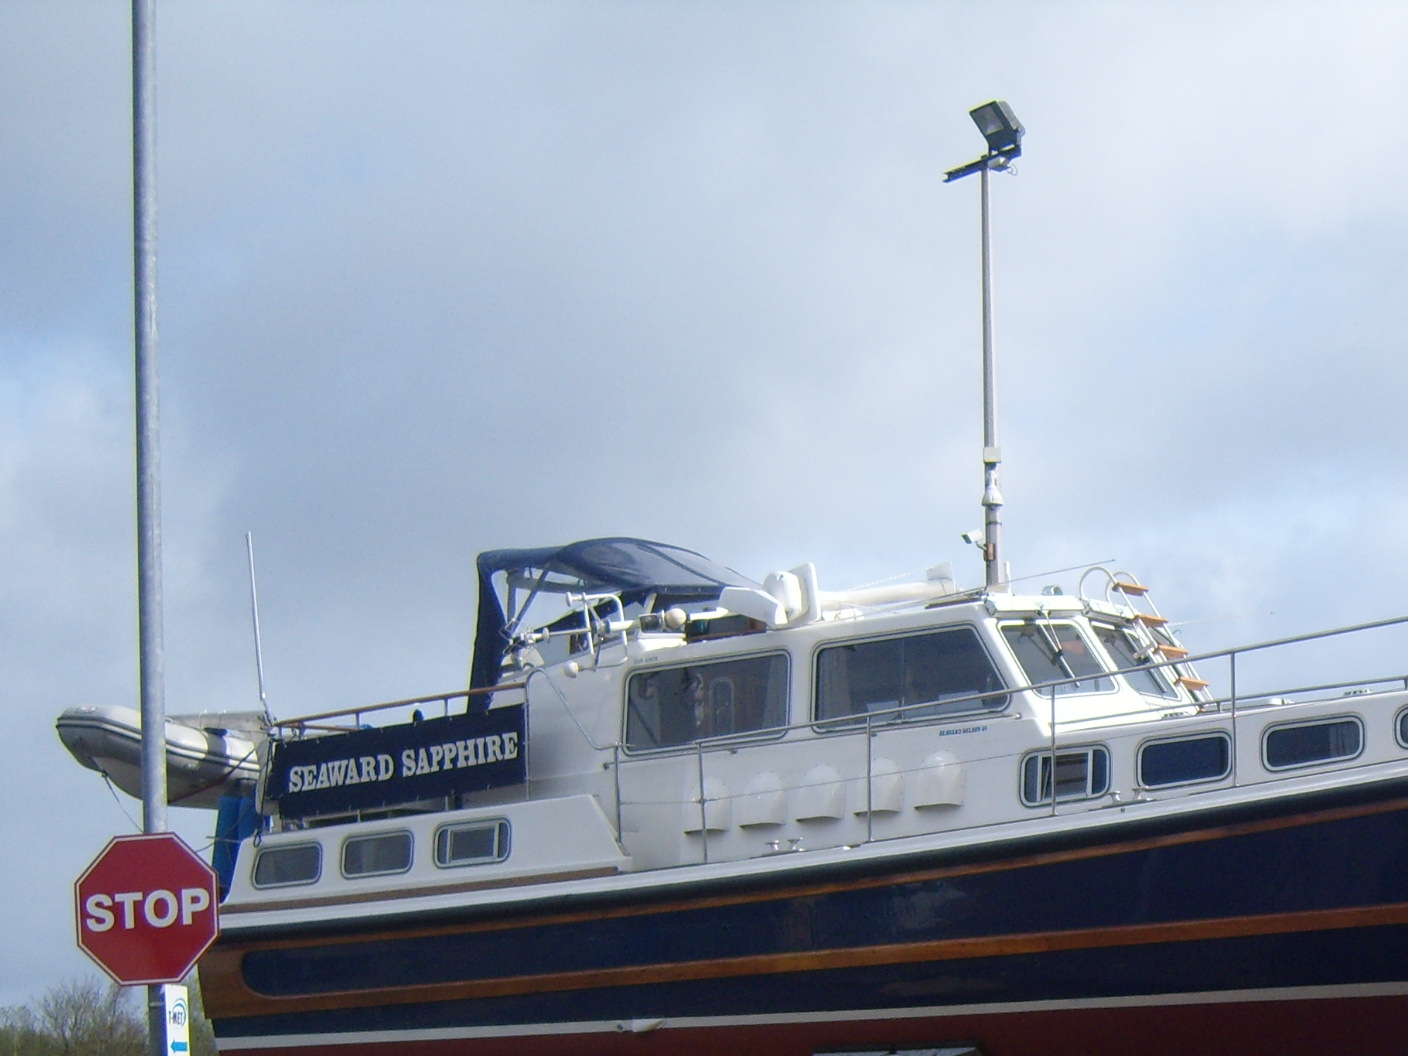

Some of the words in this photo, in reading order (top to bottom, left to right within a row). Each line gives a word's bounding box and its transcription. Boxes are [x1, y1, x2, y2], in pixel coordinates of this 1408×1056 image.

[288, 754, 394, 793] SEAWARD
[402, 731, 518, 777] SAPPHIRE
[86, 887, 210, 932] STOP
